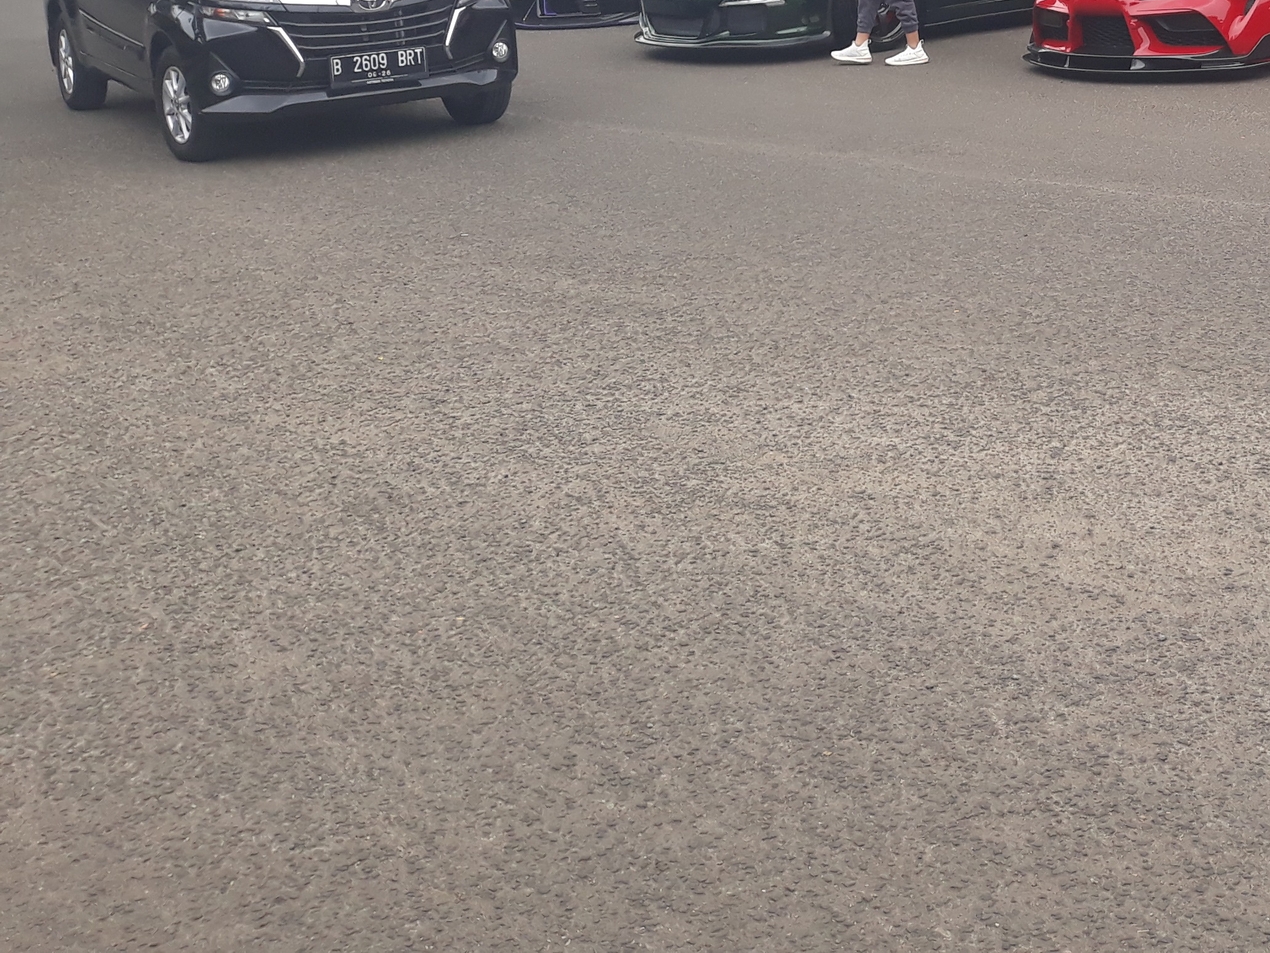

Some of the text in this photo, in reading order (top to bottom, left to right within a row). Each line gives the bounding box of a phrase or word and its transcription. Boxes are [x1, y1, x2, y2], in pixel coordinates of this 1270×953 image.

[332, 48, 424, 76] B 2609 BRT
